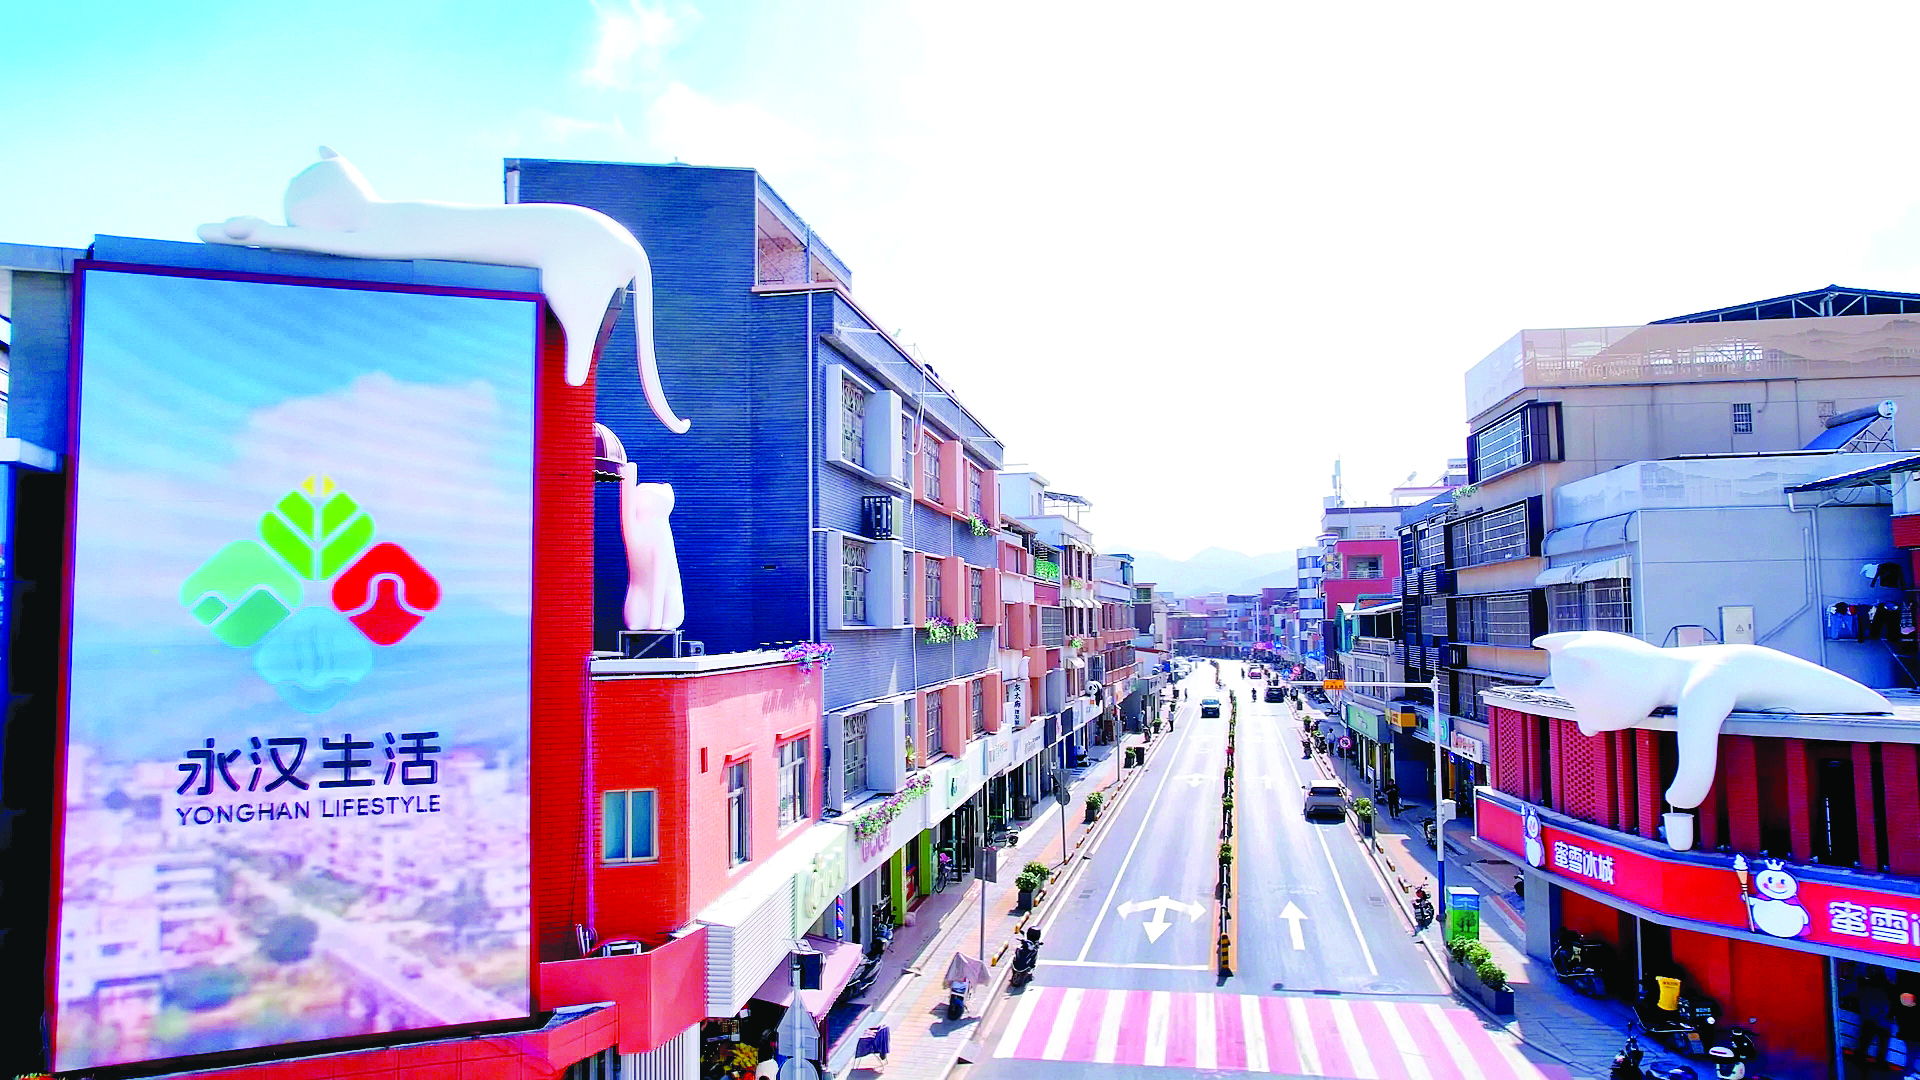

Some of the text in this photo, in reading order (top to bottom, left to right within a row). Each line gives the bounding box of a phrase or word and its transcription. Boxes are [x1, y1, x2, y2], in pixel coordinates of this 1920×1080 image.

[177, 731, 441, 796] 永汉生活
[176, 794, 441, 826] YONGHAN LIFESTYLE
[1554, 840, 1615, 886] 蜜雪冰城
